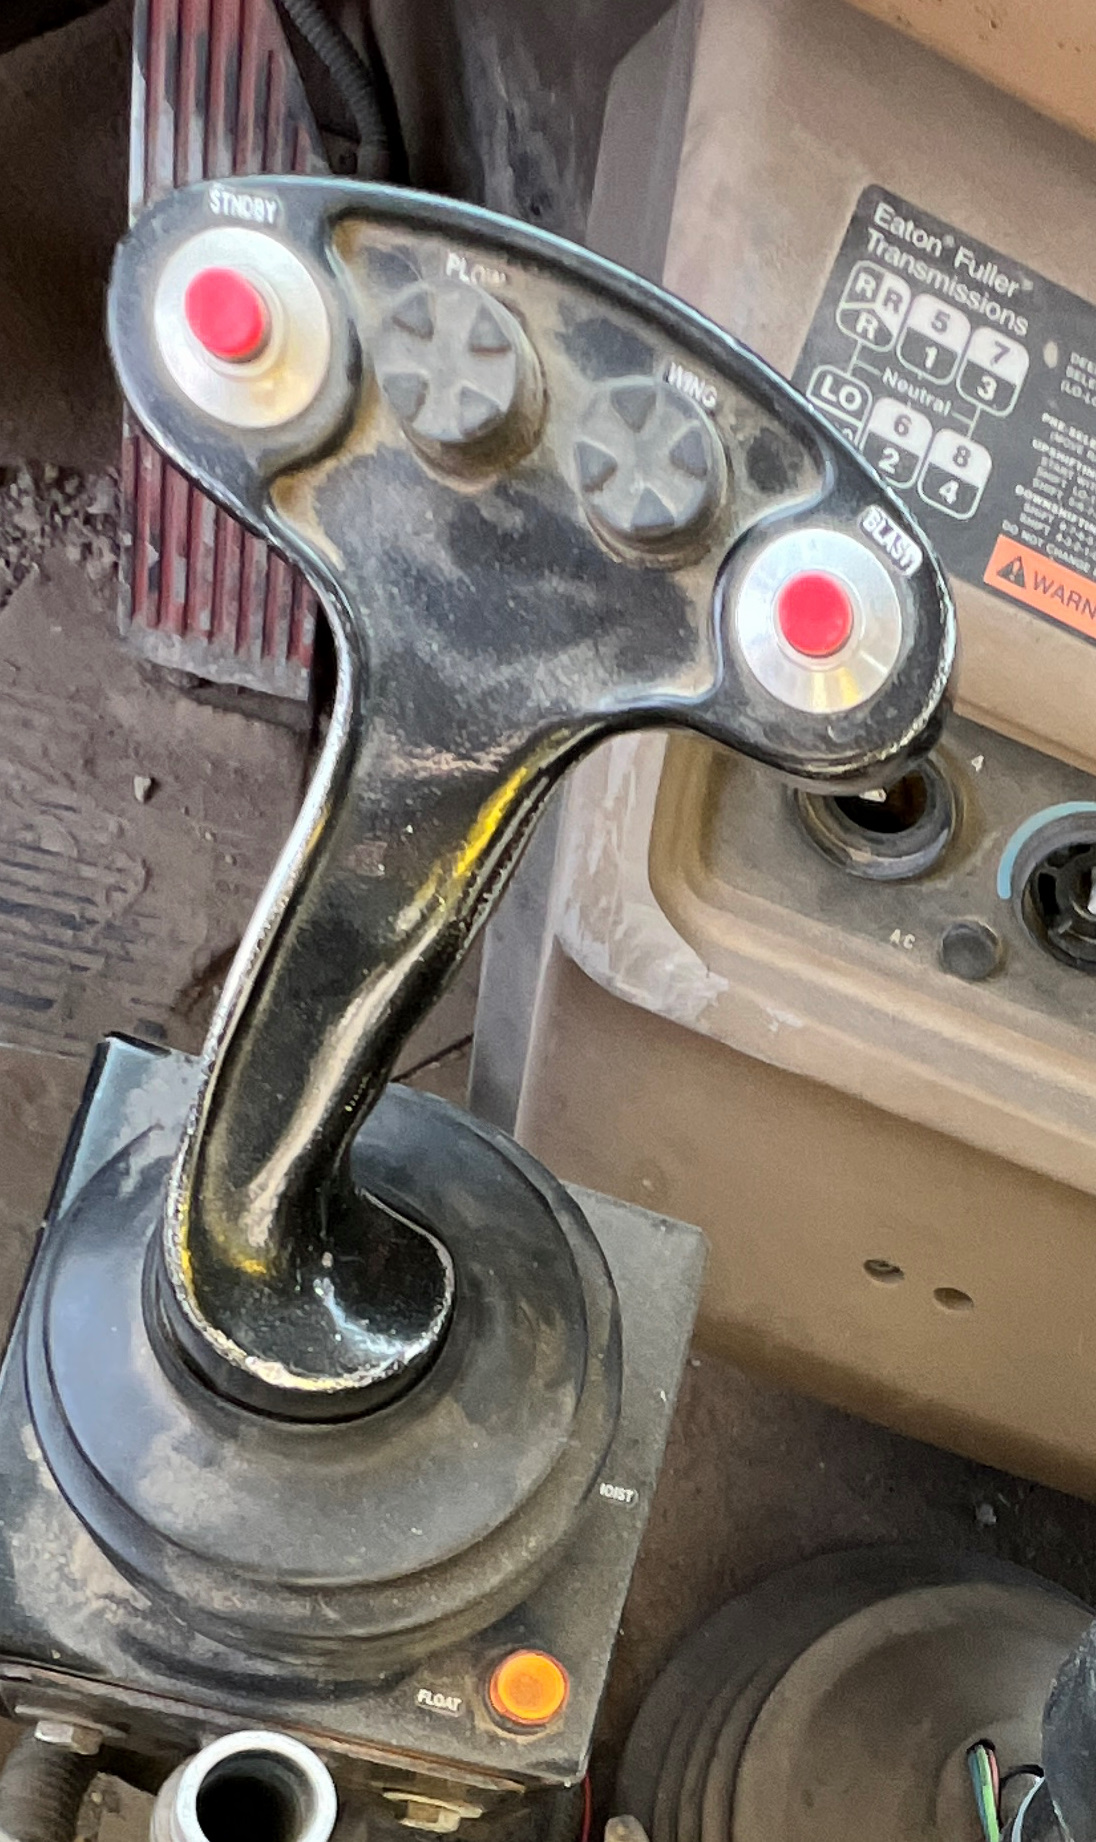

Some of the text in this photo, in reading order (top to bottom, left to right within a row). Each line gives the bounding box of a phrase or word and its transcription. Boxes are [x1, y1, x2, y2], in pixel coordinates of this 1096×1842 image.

[208, 182, 277, 224] STNDBY
[855, 272, 876, 298] R
[868, 229, 1027, 335] Transmissions
[882, 288, 902, 313] R
[856, 312, 878, 339] R
[931, 310, 950, 333] 5
[925, 346, 937, 368] 1
[990, 340, 1010, 365] 7
[666, 361, 718, 408] WING
[820, 374, 862, 410] LO
[882, 368, 951, 415] Neutral
[977, 375, 997, 400] 3
[893, 414, 911, 436] 6
[878, 447, 899, 473] 2
[952, 445, 971, 468] 8
[939, 480, 958, 504] 4
[862, 507, 920, 570] BLAST
[418, 1688, 462, 1711] FLOAT
